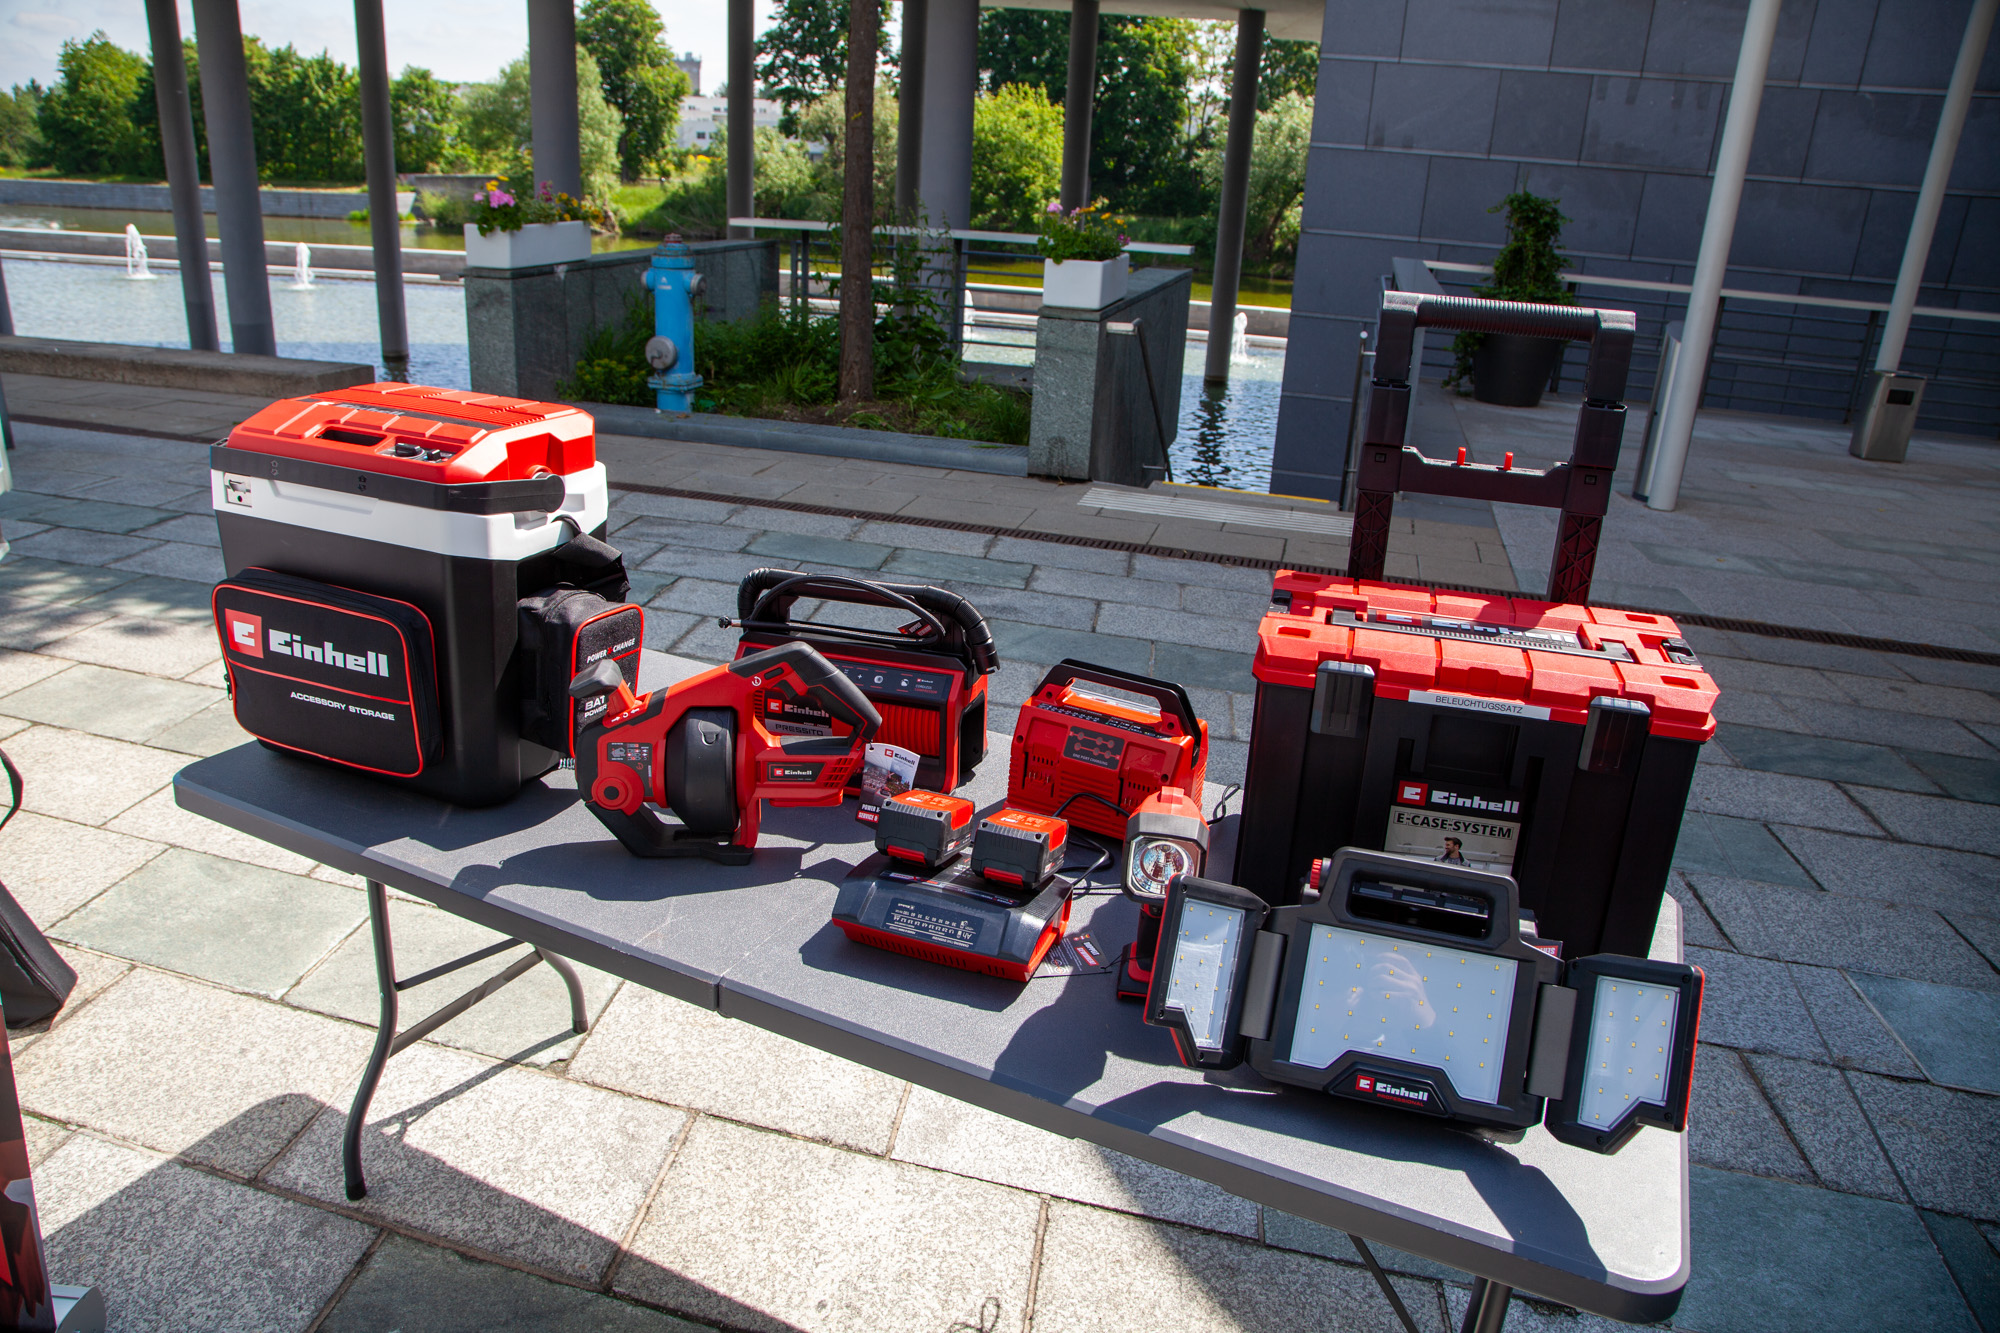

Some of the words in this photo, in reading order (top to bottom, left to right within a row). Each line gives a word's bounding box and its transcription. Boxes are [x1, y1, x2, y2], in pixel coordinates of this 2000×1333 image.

[1431, 618, 1576, 643] Einhell
[269, 628, 390, 678] Einhell
[586, 649, 607, 664] POWER
[290, 691, 346, 711] ACCESSORY
[349, 705, 395, 721] STORAGE
[1435, 695, 1523, 714] BELEUCHTUGSSATZ
[775, 723, 824, 736] PRESSITO
[1430, 789, 1520, 814] Einhell
[1375, 1082, 1428, 1101] Einhell
[1377, 1093, 1424, 1106] PROFESSIONAL
